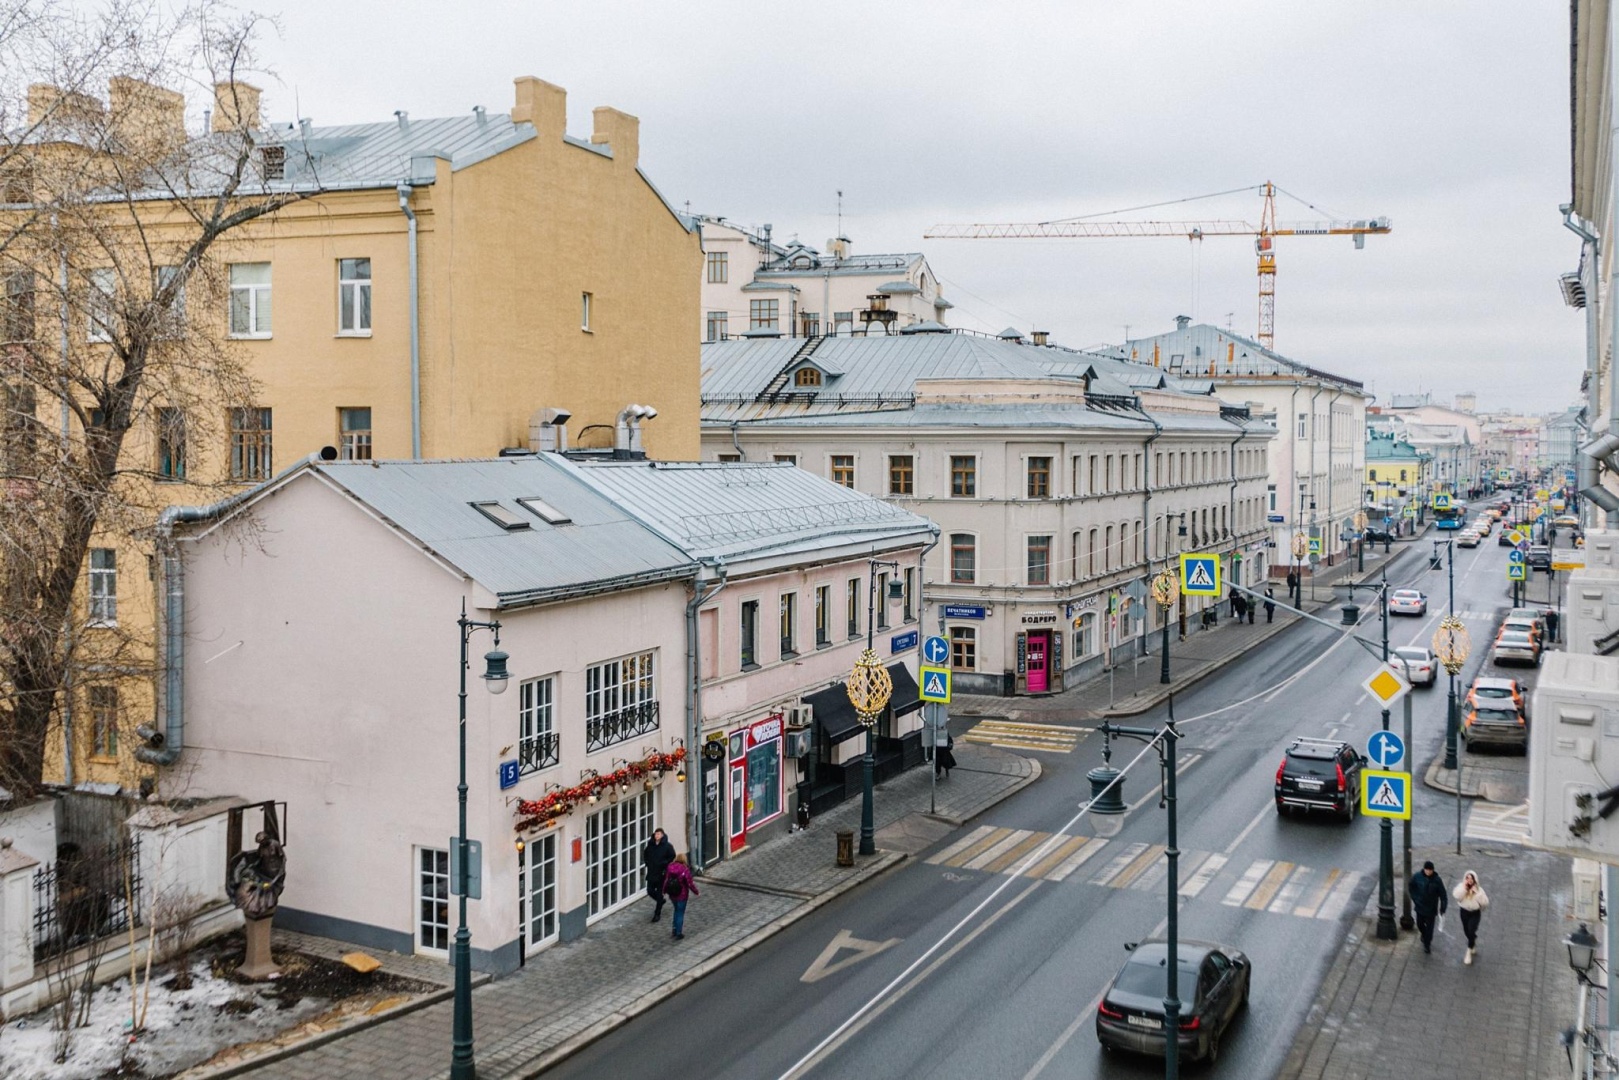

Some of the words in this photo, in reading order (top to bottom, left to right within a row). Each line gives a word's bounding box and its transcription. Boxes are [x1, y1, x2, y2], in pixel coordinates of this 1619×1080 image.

[1021, 615, 1057, 624] БОДРЕРО
[912, 634, 917, 644] 7
[508, 765, 514, 779] 5
